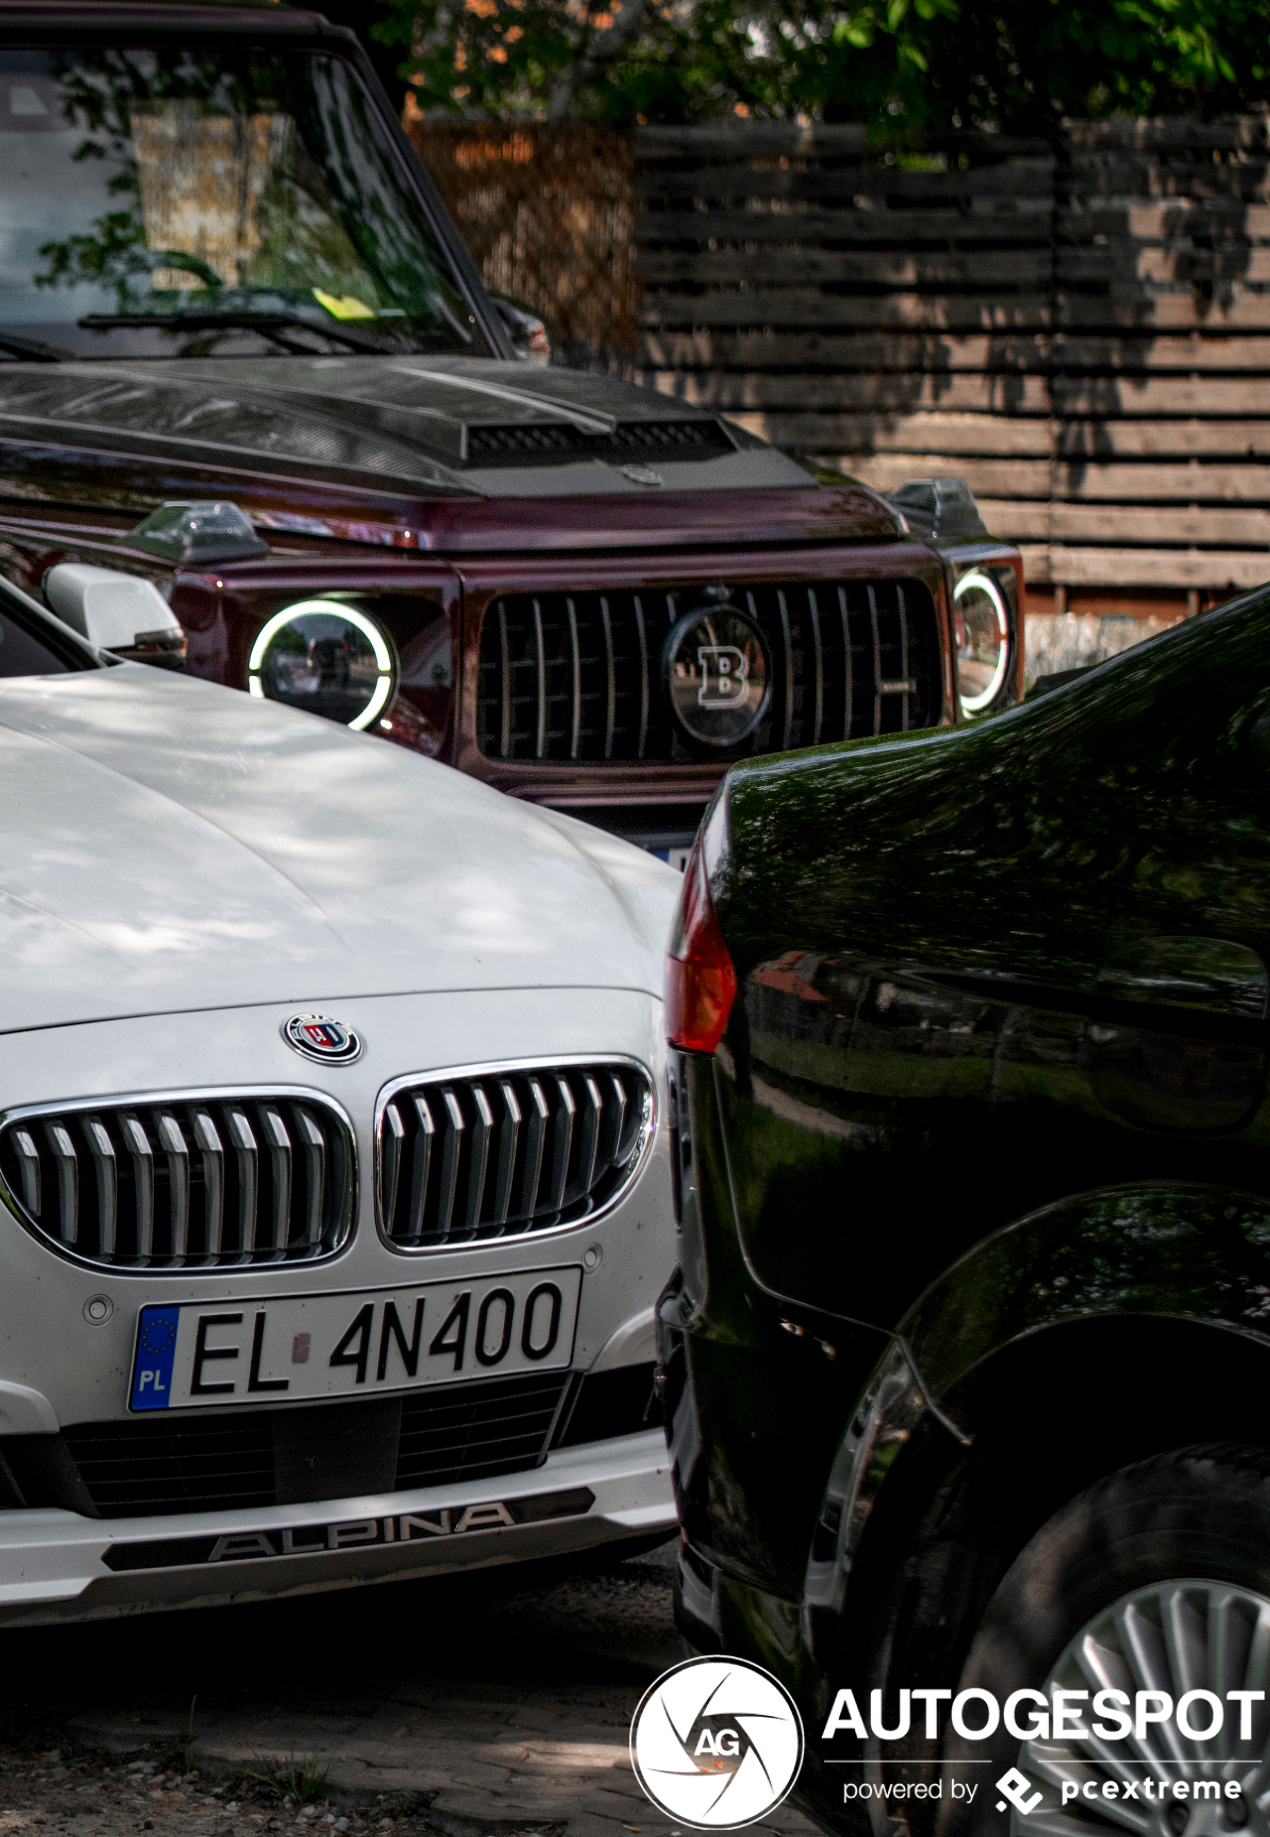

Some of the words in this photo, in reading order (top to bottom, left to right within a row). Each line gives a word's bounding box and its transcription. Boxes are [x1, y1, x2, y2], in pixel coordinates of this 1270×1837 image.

[190, 1312, 290, 1396] EL
[329, 1282, 563, 1384] 4N400
[139, 1371, 165, 1392] PL
[207, 1502, 516, 1562] ALPINA
